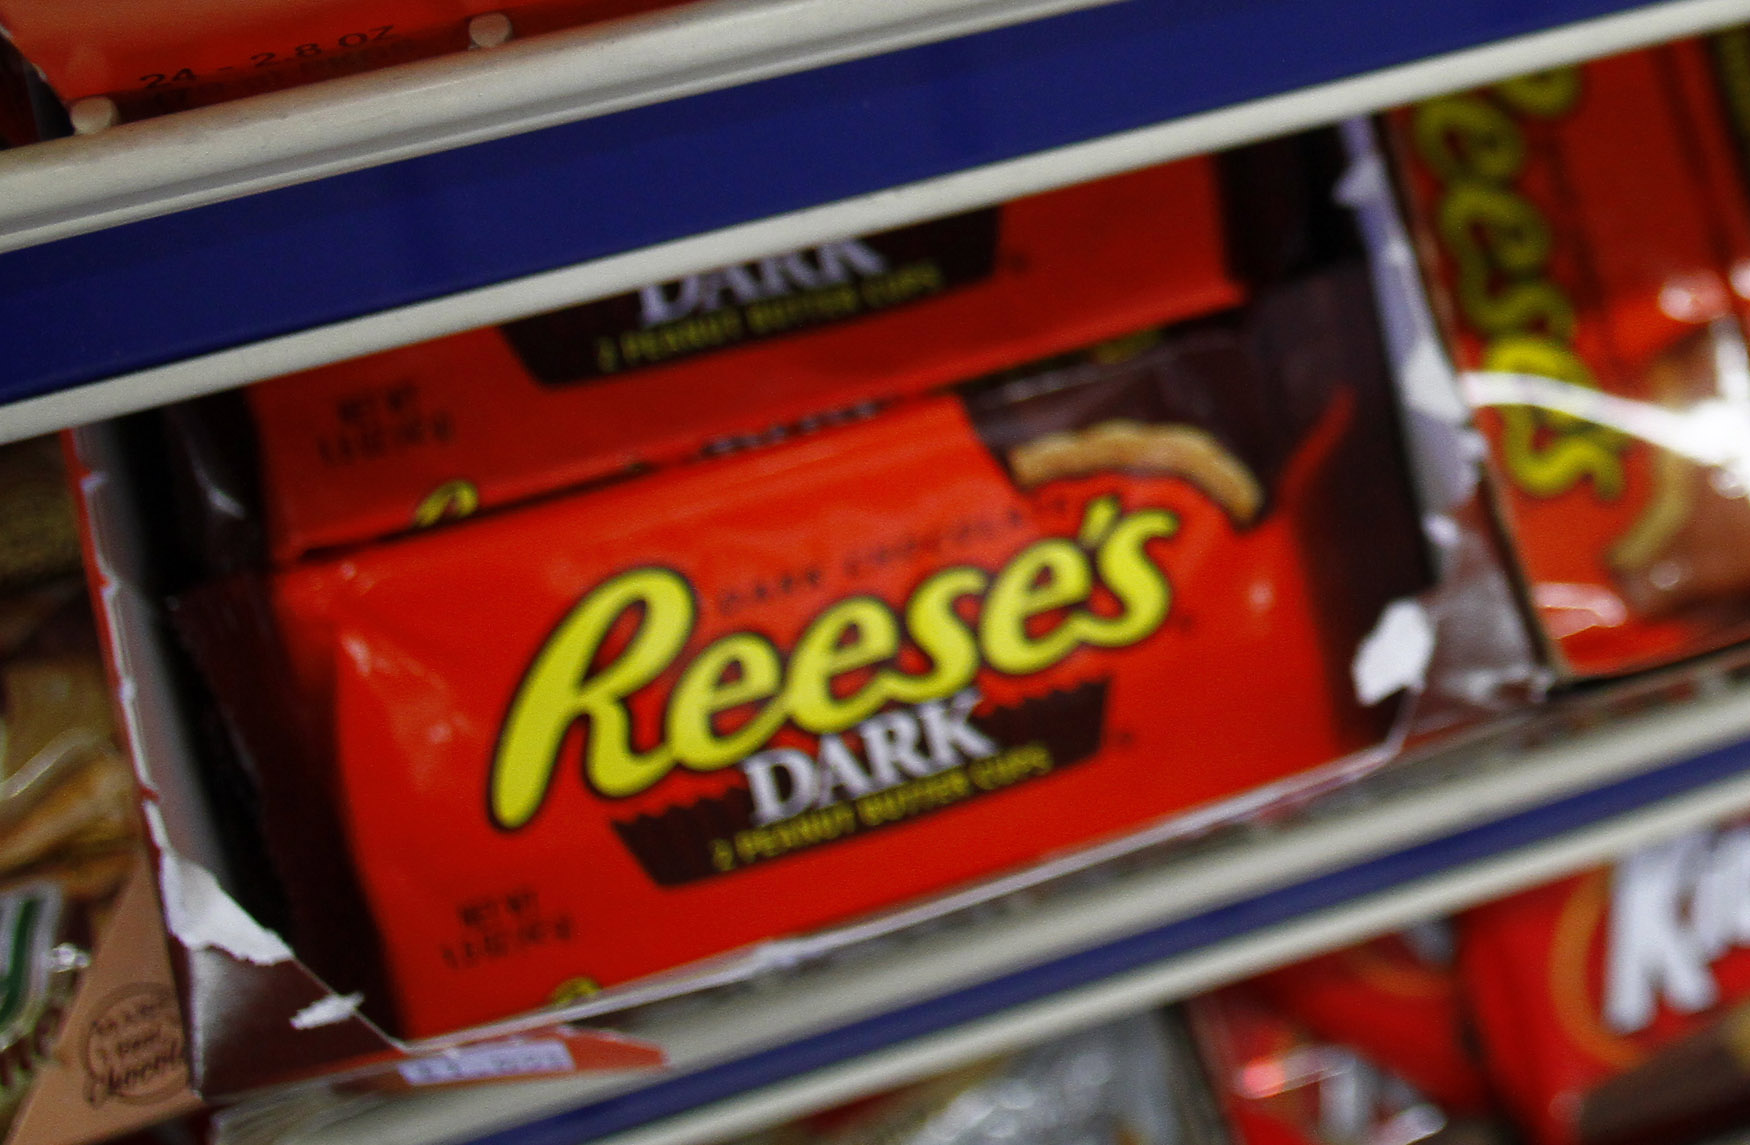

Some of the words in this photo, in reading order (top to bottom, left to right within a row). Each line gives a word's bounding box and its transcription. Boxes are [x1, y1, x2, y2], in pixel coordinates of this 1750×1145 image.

[139, 68, 196, 90] 24
[337, 24, 396, 50] OZ
[488, 494, 1182, 833] Reese's
[742, 686, 998, 826] DARK
